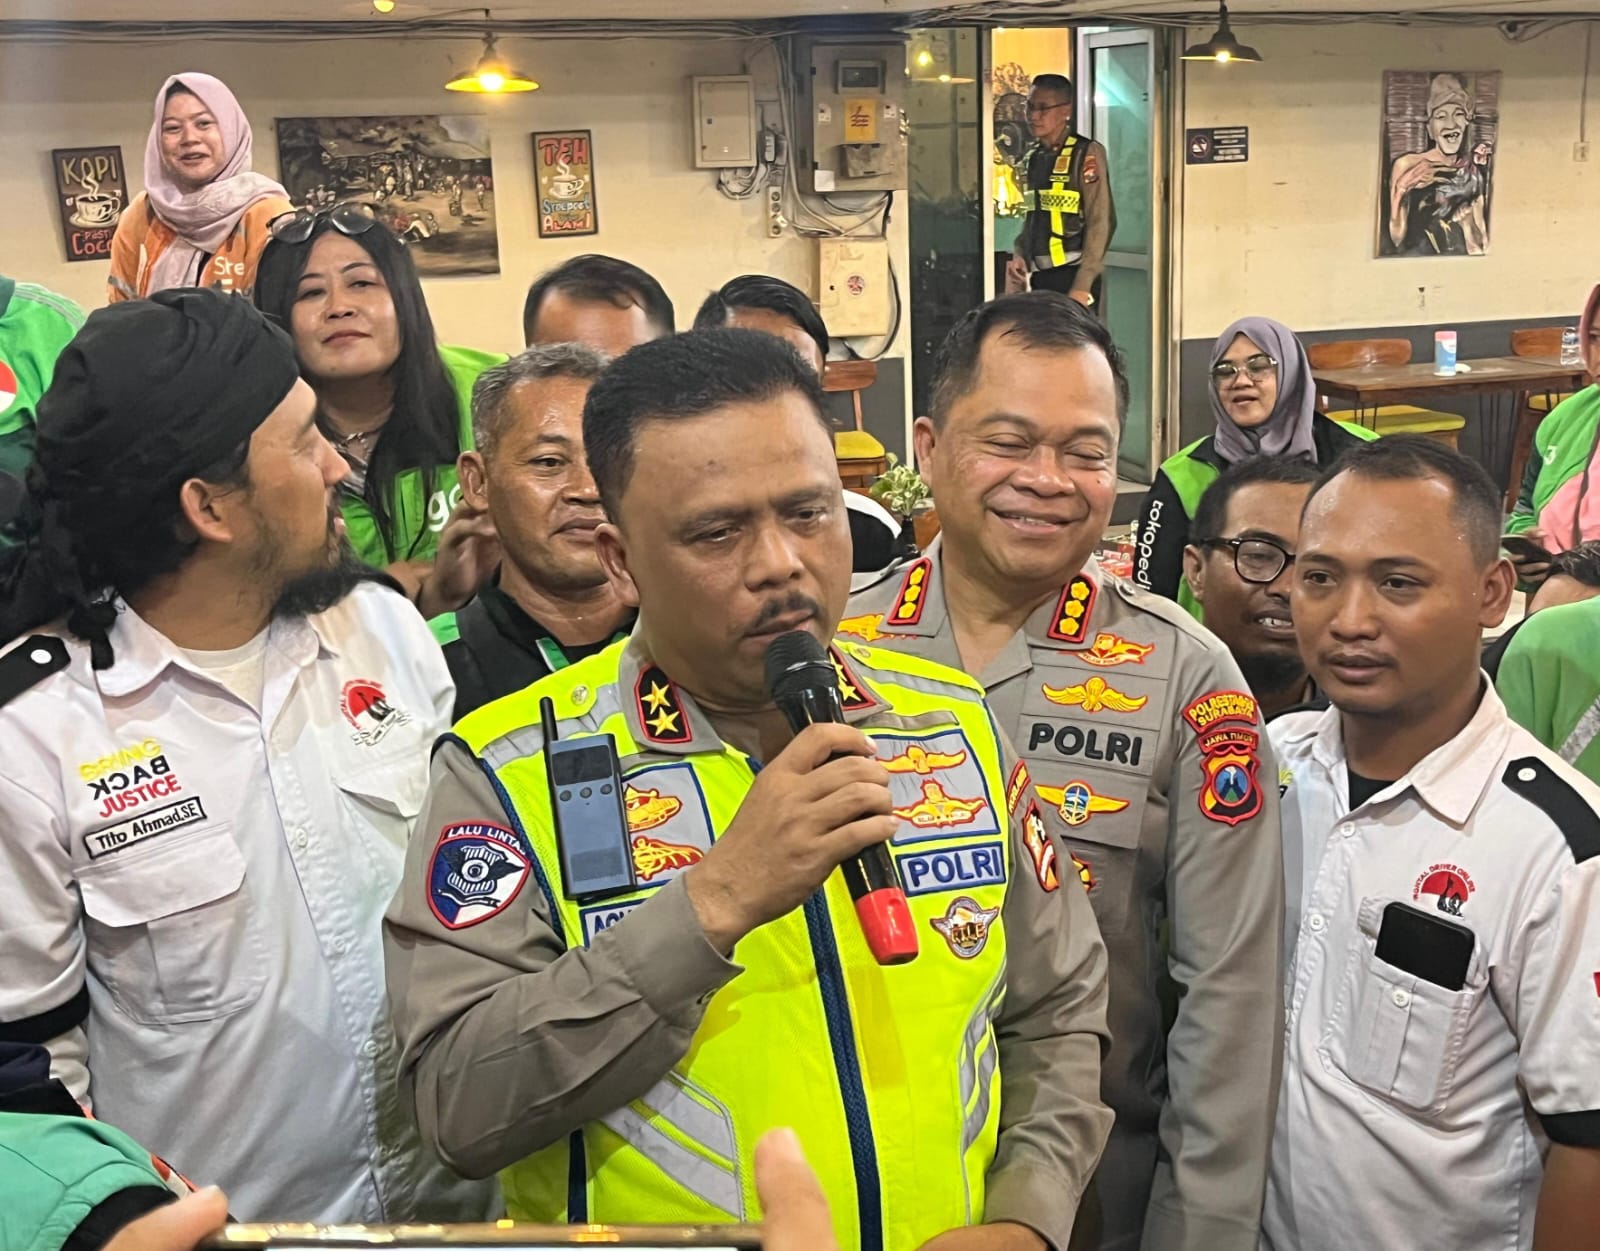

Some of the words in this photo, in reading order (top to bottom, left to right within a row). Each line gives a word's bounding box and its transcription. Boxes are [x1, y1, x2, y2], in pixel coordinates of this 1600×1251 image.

[538, 137, 588, 166] TEH
[62, 157, 116, 184] KOPI
[1136, 499, 1164, 590] tokopedi
[1029, 723, 1142, 766] POLRI
[1205, 733, 1228, 746] JAWA
[100, 774, 181, 818] JUSTICE
[448, 826, 483, 837] LALU
[487, 828, 526, 855] LINTA
[908, 849, 999, 887] POLRI
